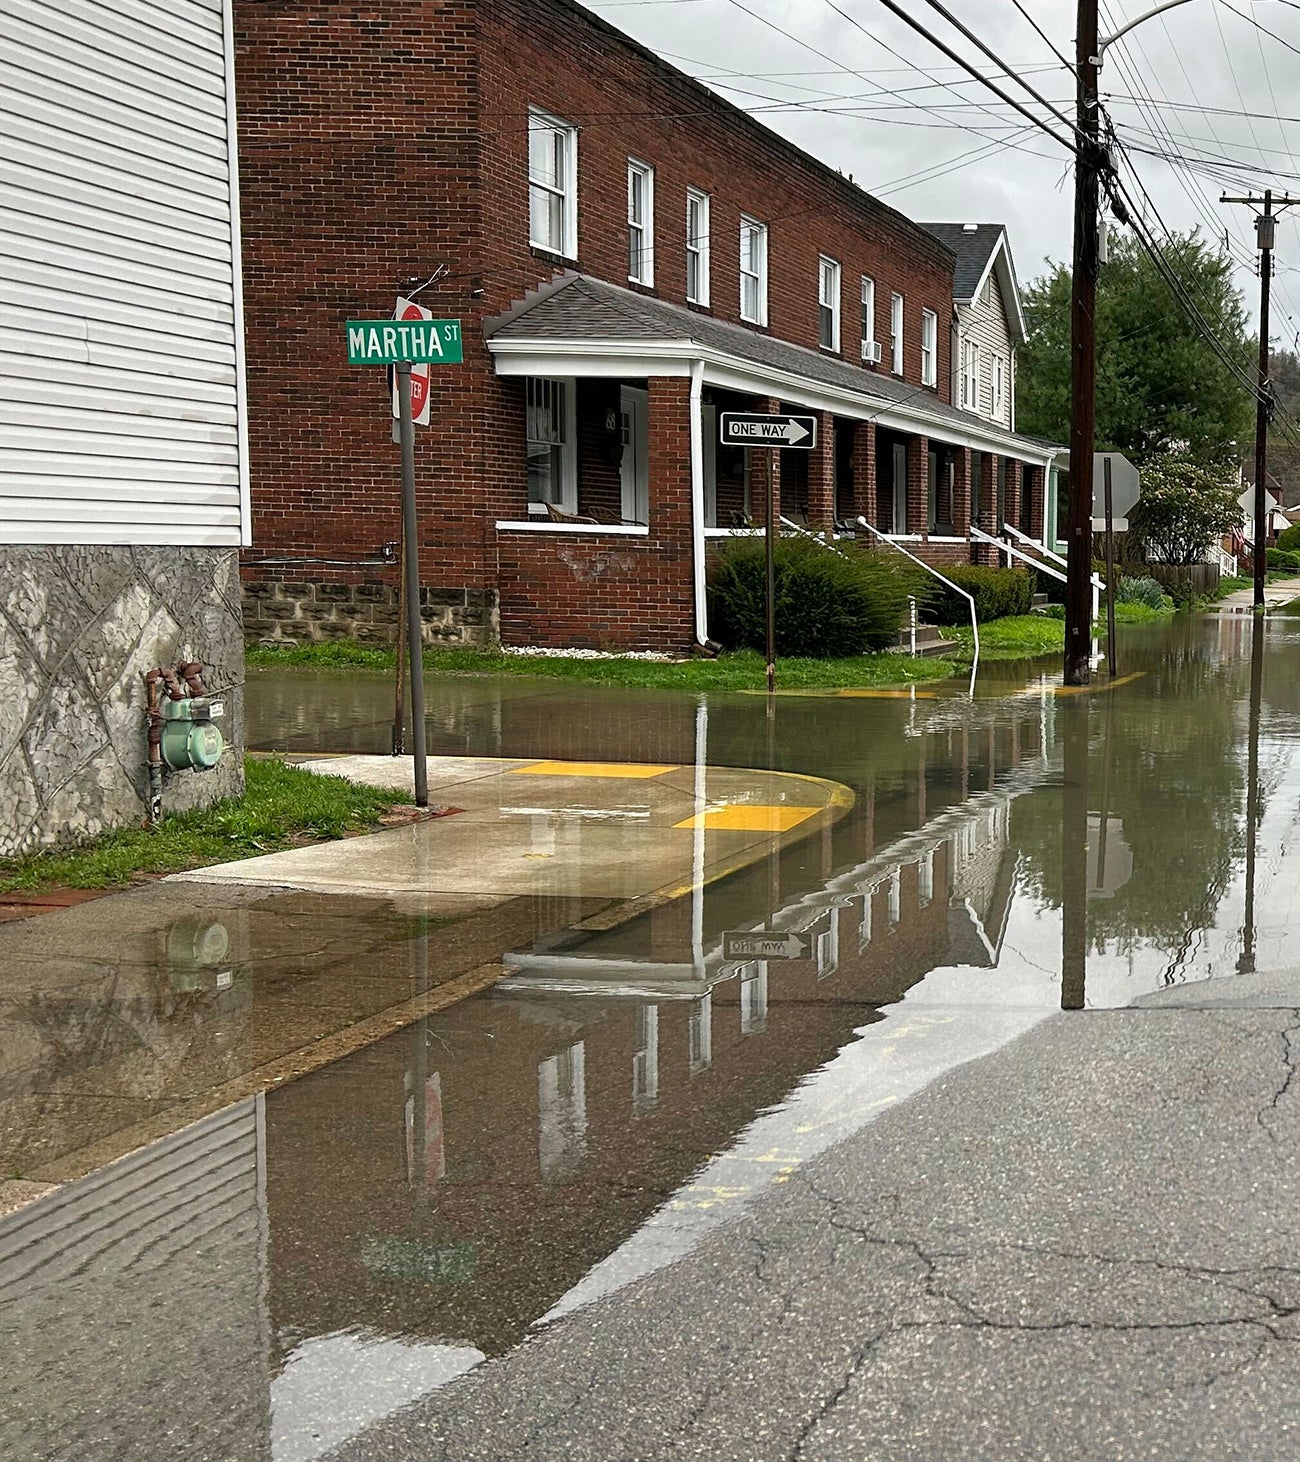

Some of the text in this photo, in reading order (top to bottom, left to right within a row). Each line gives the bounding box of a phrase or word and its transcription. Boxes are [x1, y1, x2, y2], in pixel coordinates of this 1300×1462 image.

[349, 325, 458, 358] MARTHA ST
[411, 380, 422, 400] TER
[732, 423, 786, 437] ONE WAY
